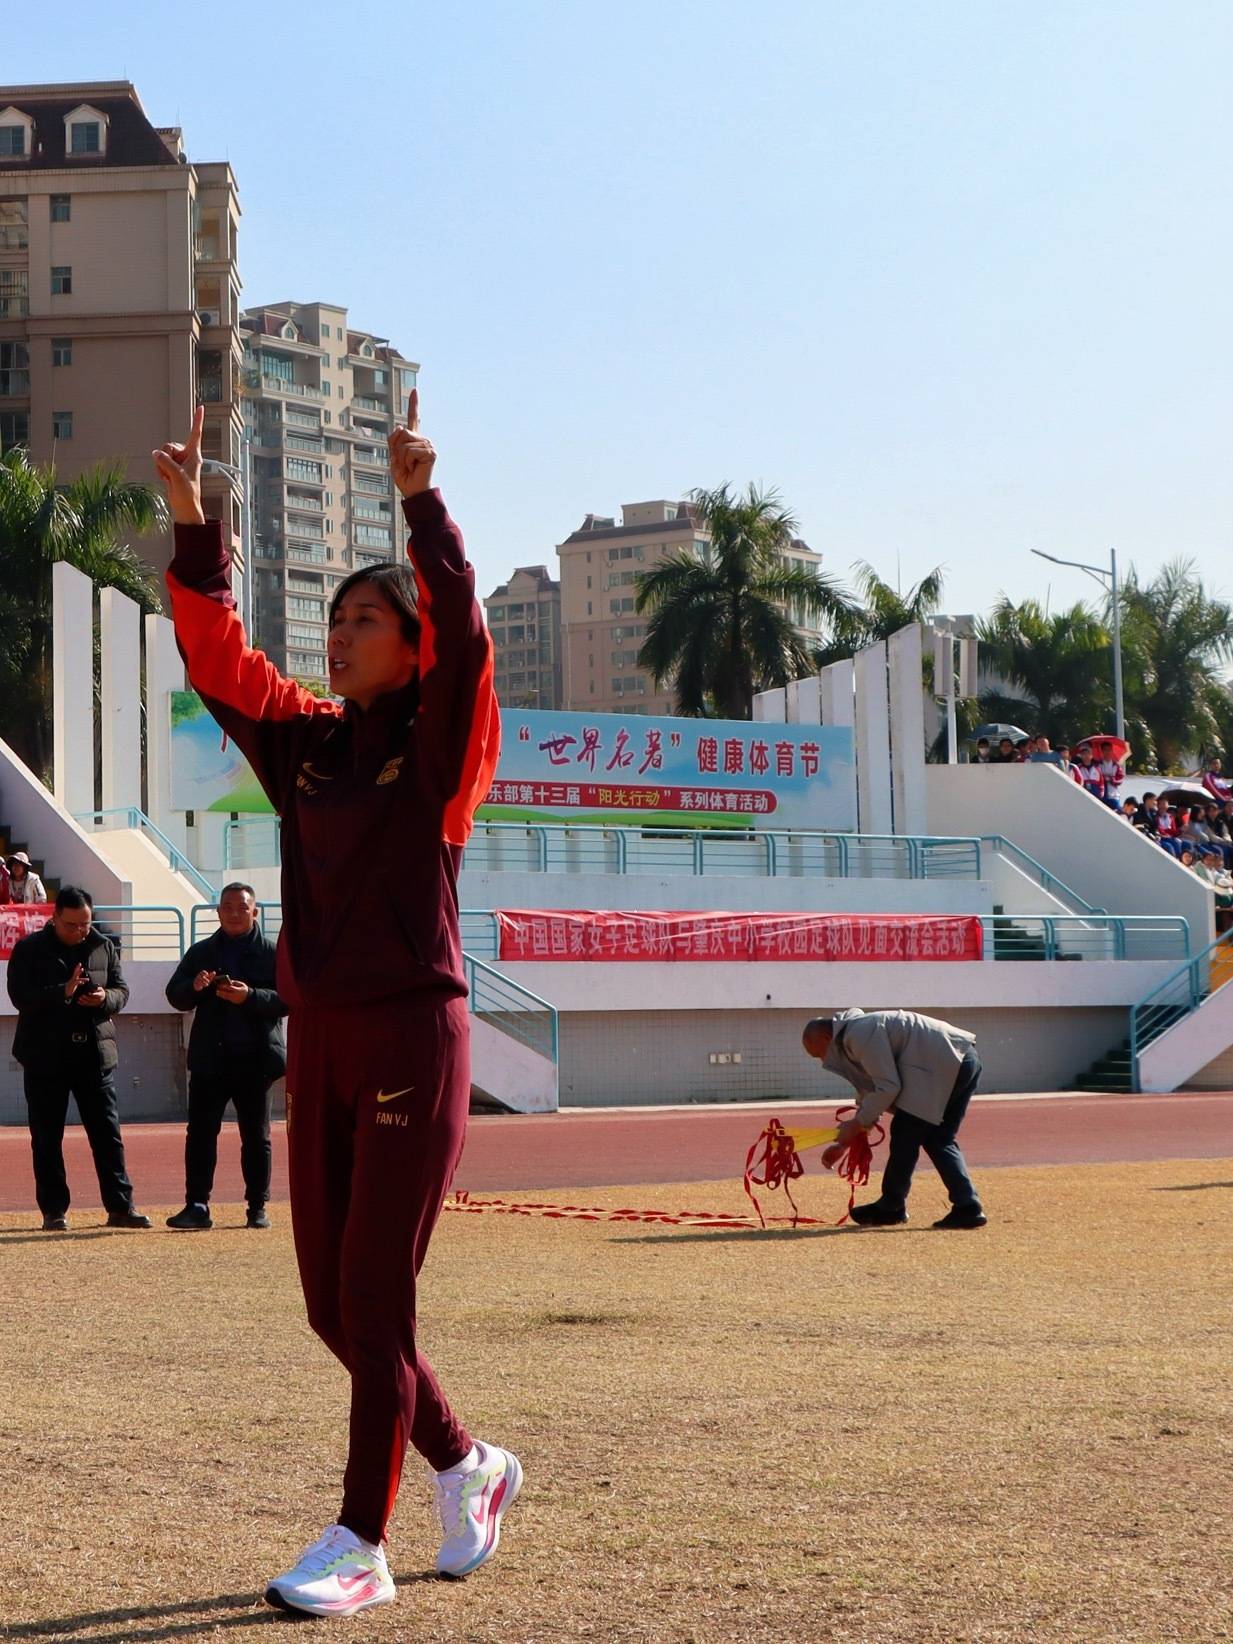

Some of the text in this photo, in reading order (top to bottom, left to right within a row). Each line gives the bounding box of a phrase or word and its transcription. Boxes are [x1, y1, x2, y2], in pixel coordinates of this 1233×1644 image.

[484, 783, 768, 812] 乐部第十三届“阳光行动”系列体育活动
[375, 1111, 393, 1125] FAN
